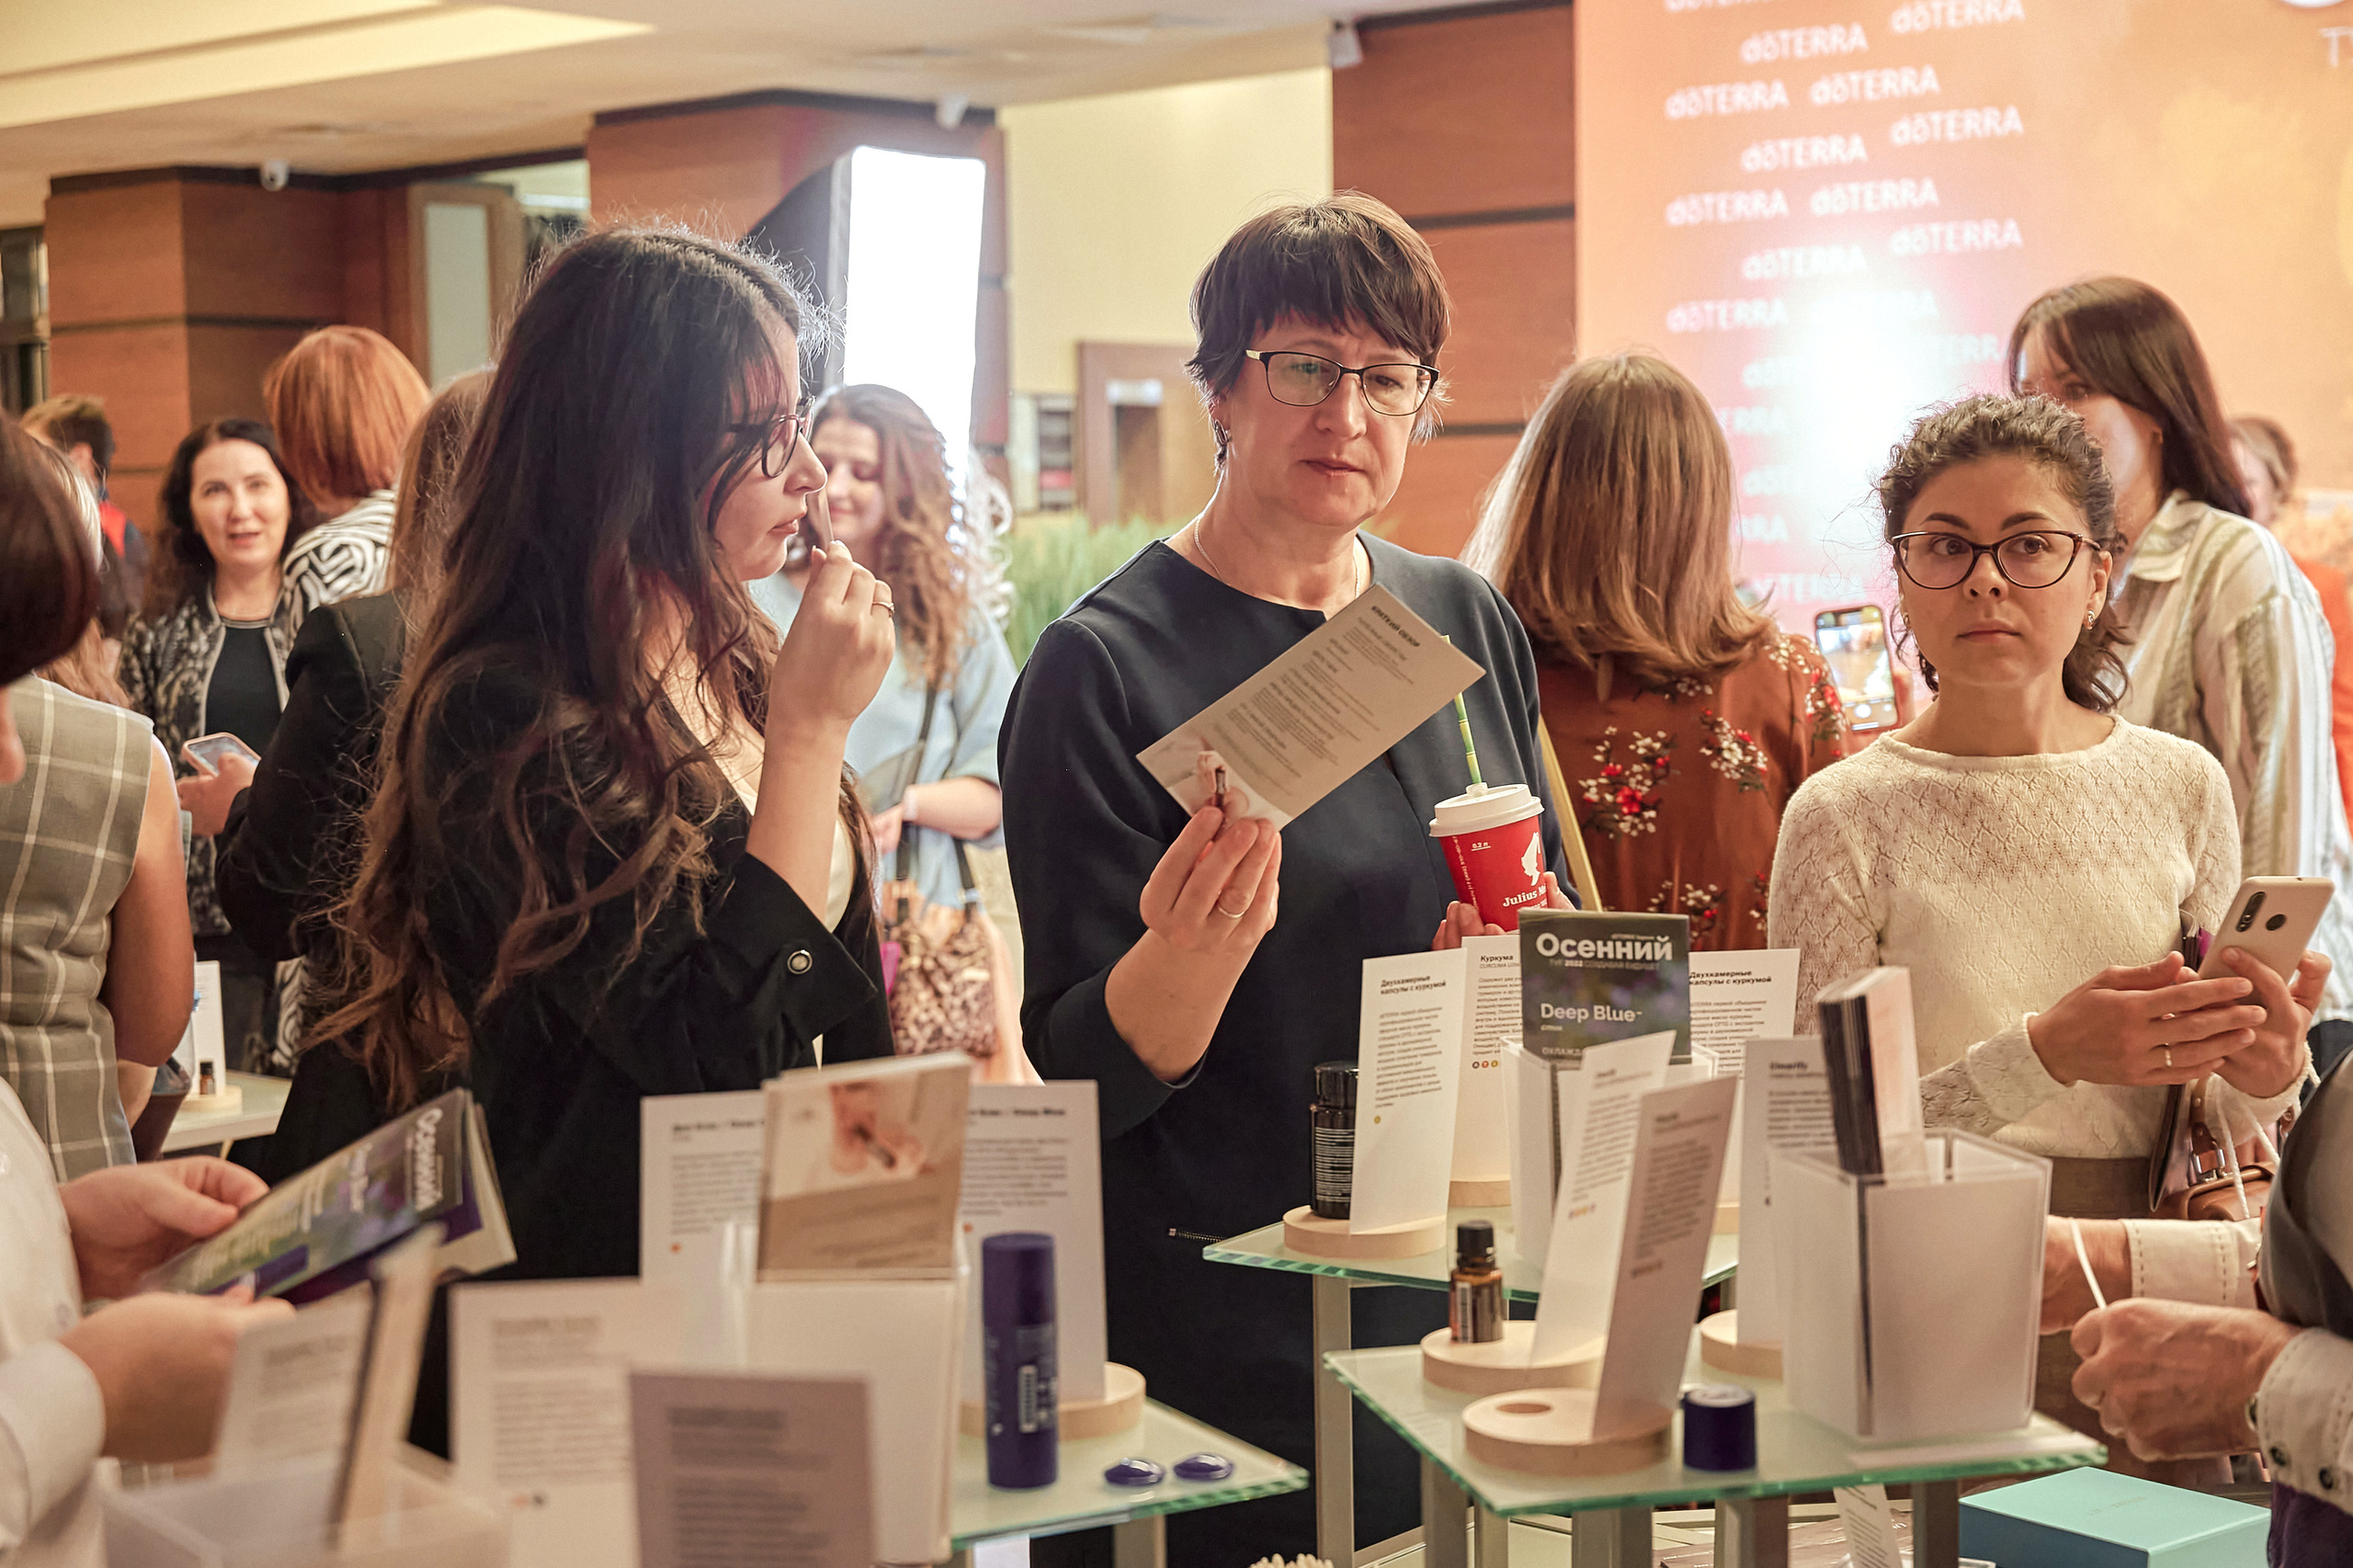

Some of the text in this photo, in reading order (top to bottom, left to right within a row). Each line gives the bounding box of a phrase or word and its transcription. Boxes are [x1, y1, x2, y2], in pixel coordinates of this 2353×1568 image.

[1503, 890, 1538, 907] Julius
[1536, 932, 1673, 960] Осенний
[1381, 975, 1431, 988] Двухкамерные
[1689, 971, 1752, 979] Двухкамерные
[1733, 976, 1772, 985] куркумой
[1381, 985, 1408, 994] капсулы
[1415, 981, 1447, 992] куркумой
[1540, 1003, 1589, 1023] Deep
[1541, 1047, 1582, 1056] ОХЛАЖД
